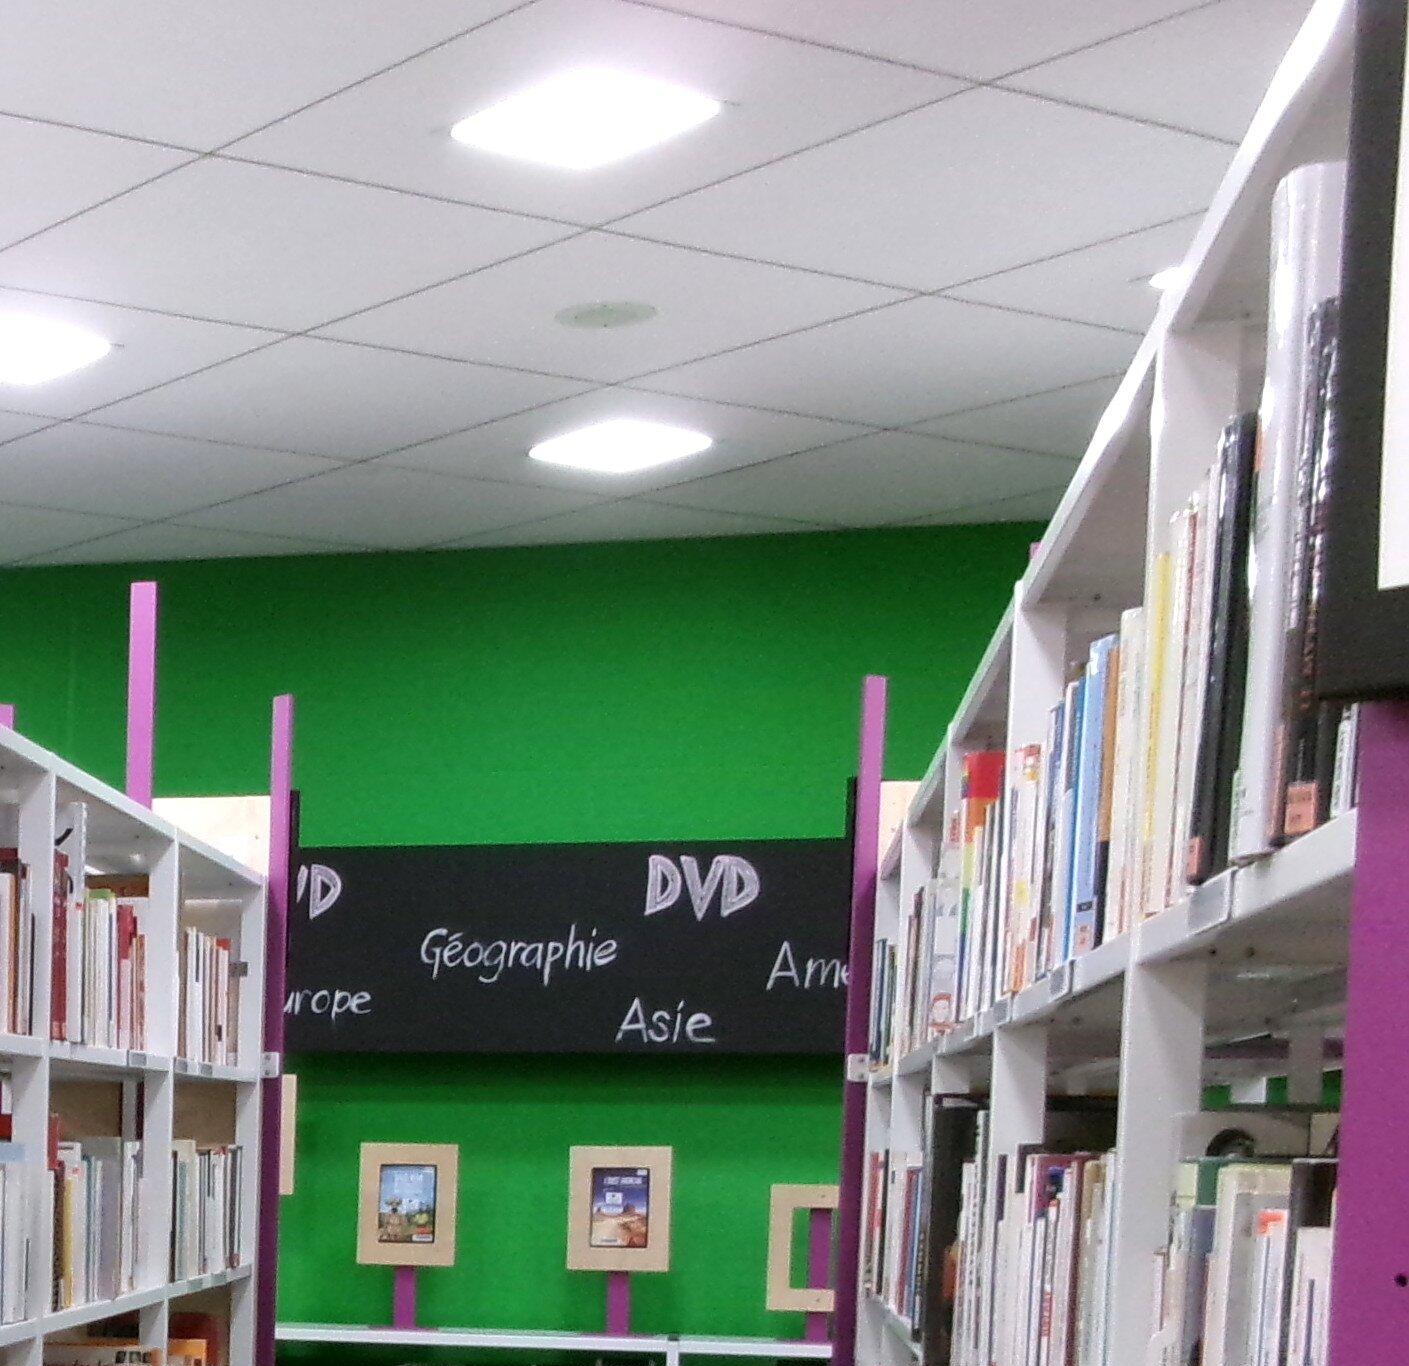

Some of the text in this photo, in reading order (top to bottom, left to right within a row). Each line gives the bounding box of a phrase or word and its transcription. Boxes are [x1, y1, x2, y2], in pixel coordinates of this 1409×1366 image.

[644, 854, 760, 921] DVD
[420, 923, 618, 985] Géographie
[615, 997, 716, 1044] Asie
